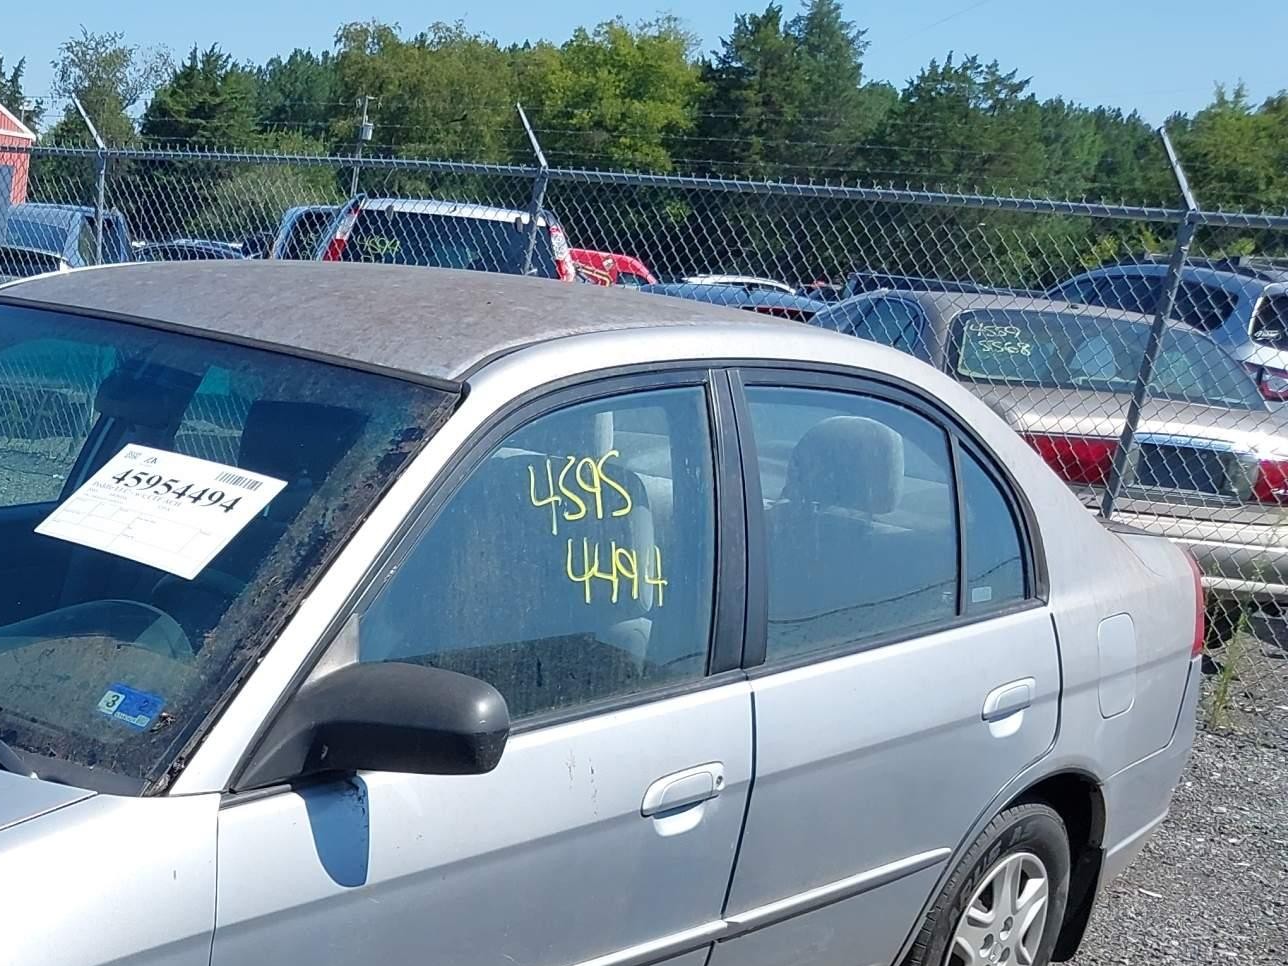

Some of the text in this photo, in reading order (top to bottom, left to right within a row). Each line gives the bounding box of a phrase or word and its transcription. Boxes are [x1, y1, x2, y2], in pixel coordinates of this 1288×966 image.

[111, 467, 243, 514] 45954494
[528, 449, 633, 535] 4595
[567, 537, 668, 607] 4494
[105, 694, 121, 708] 3
